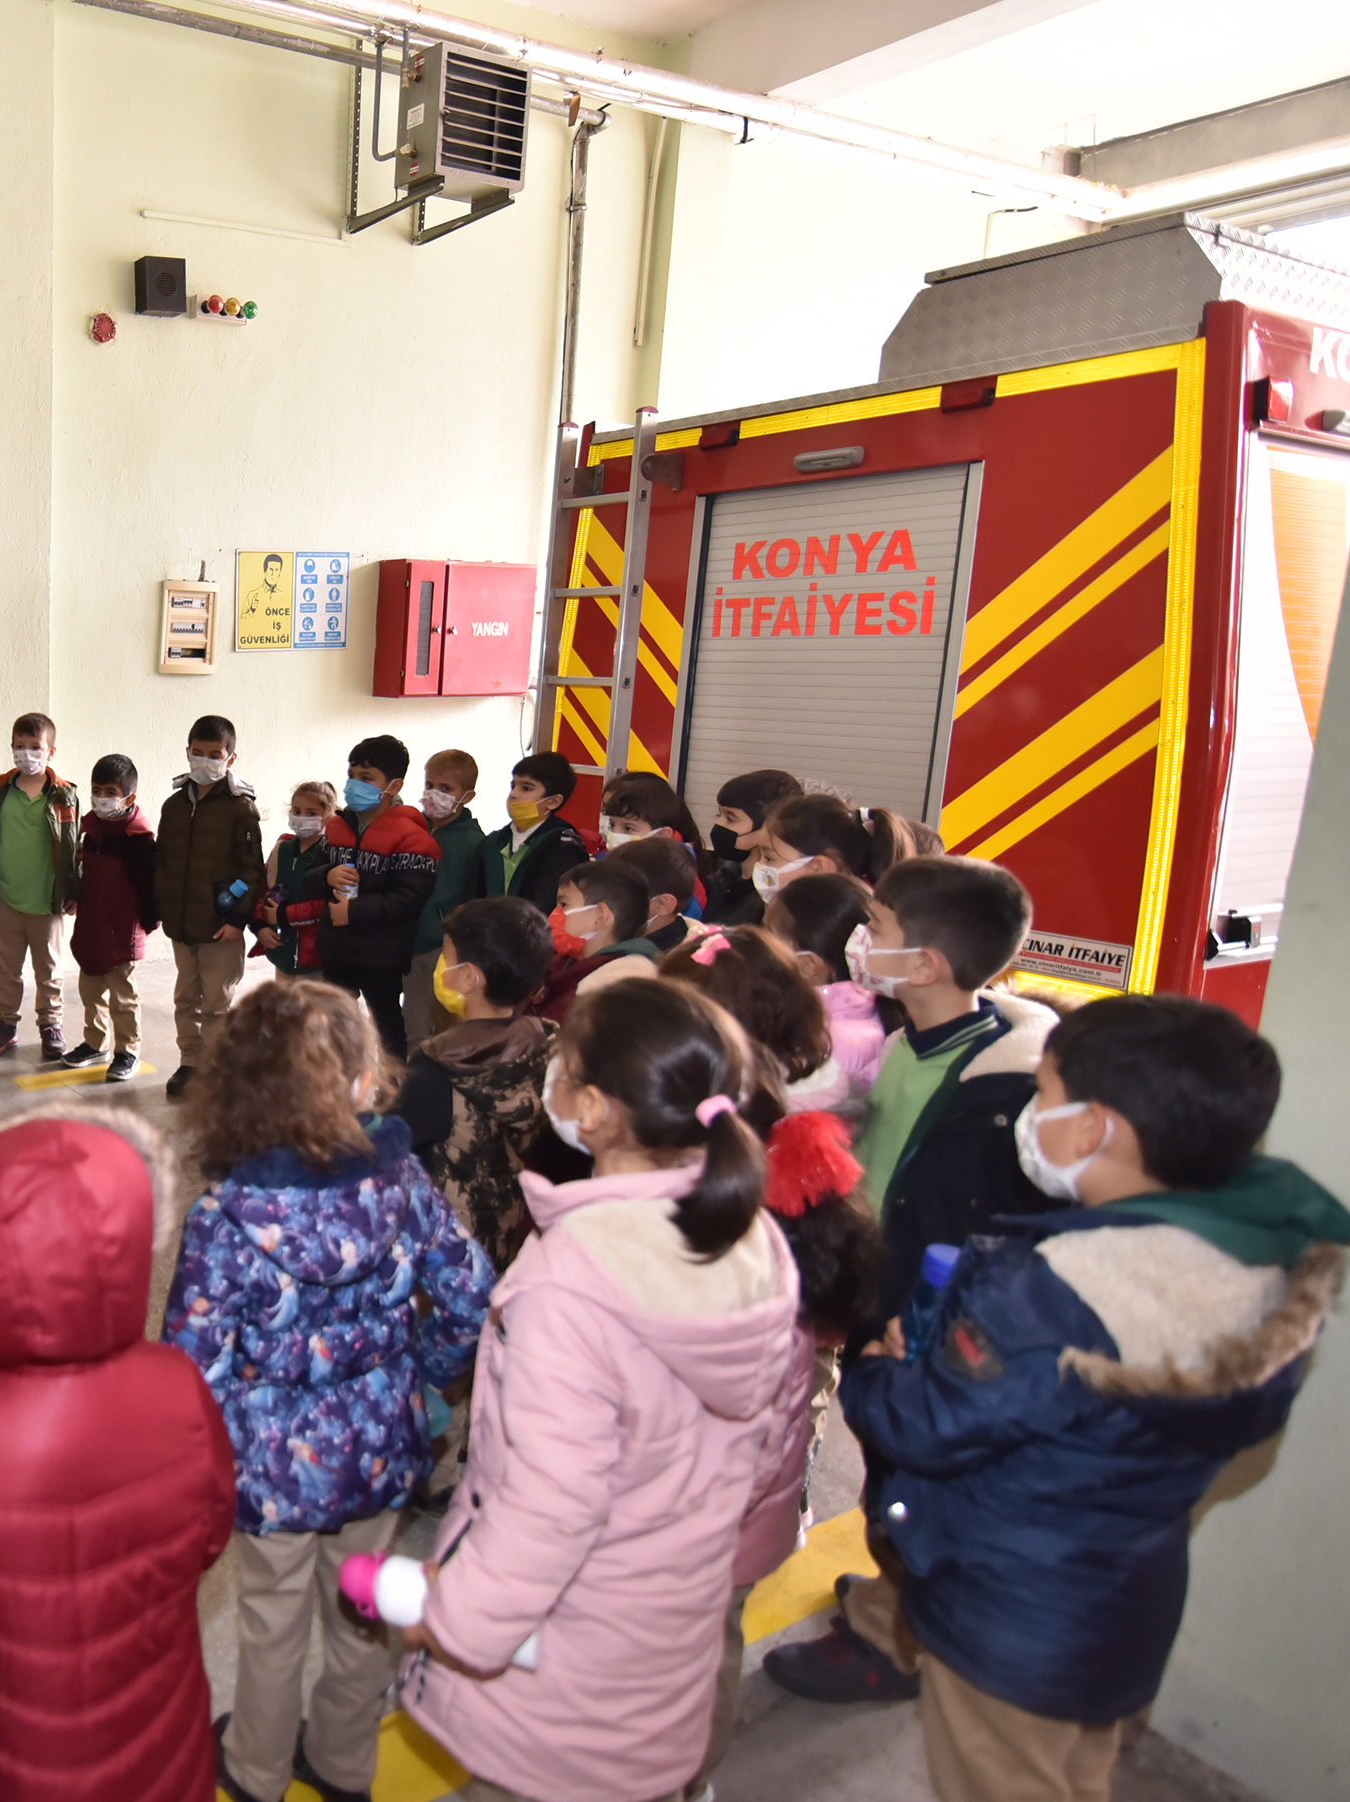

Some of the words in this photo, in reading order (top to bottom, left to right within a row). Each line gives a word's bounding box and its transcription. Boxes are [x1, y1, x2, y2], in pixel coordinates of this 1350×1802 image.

[731, 529, 917, 580] KONYA
[265, 606, 290, 616] ÖNCE
[711, 576, 936, 637] İTFAİYESİ
[272, 620, 282, 631] İŞ
[471, 621, 509, 637] YANGIN
[239, 634, 290, 645] GÜVENLİĞİ
[1068, 941, 1126, 968] İTFAİYE
